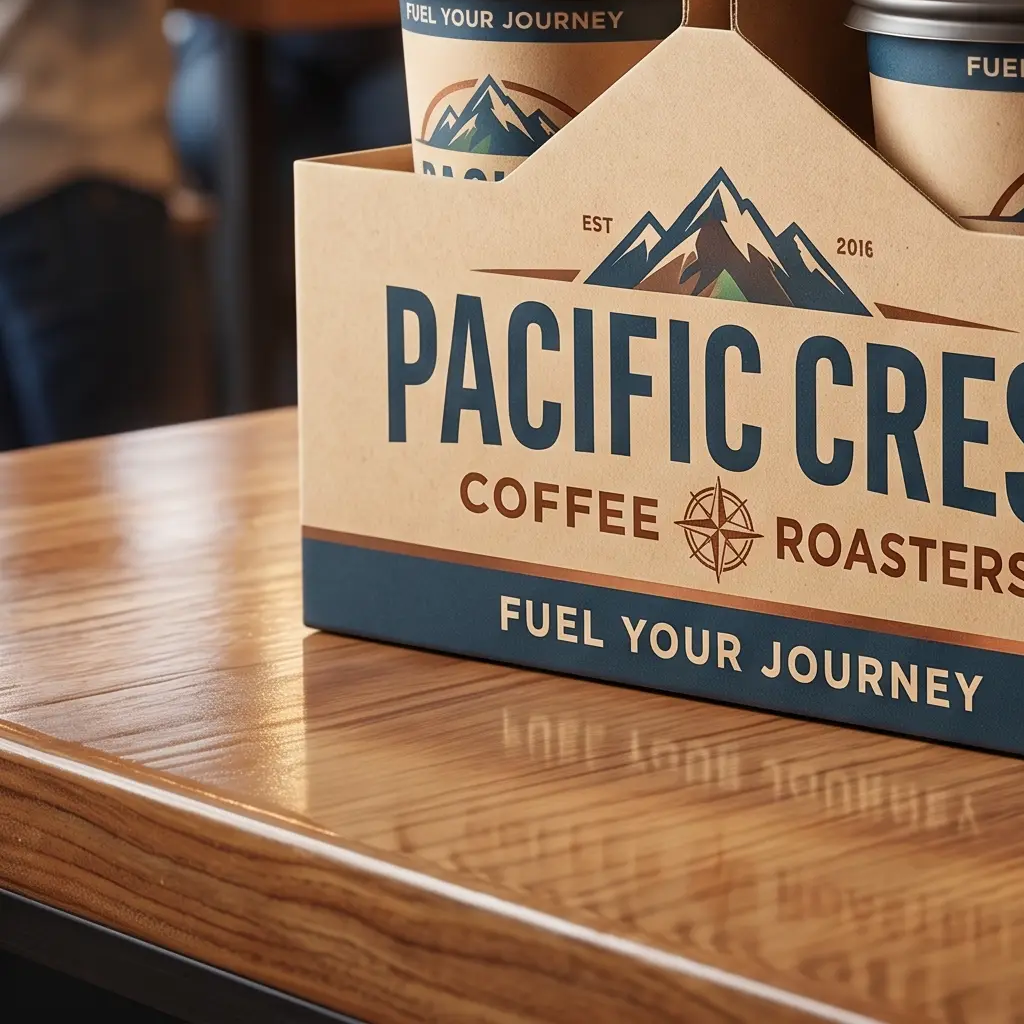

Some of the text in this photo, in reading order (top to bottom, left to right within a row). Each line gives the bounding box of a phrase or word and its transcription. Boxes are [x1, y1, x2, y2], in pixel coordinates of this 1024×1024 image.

[406, 2, 624, 30] FUEL YOUR JOURNEY
[582, 214, 874, 258] EST 2016
[385, 284, 762, 472] PACIFIC
[459, 471, 660, 541] COFFEE
[500, 594, 984, 712] FUEL YOUR JOURNEY
